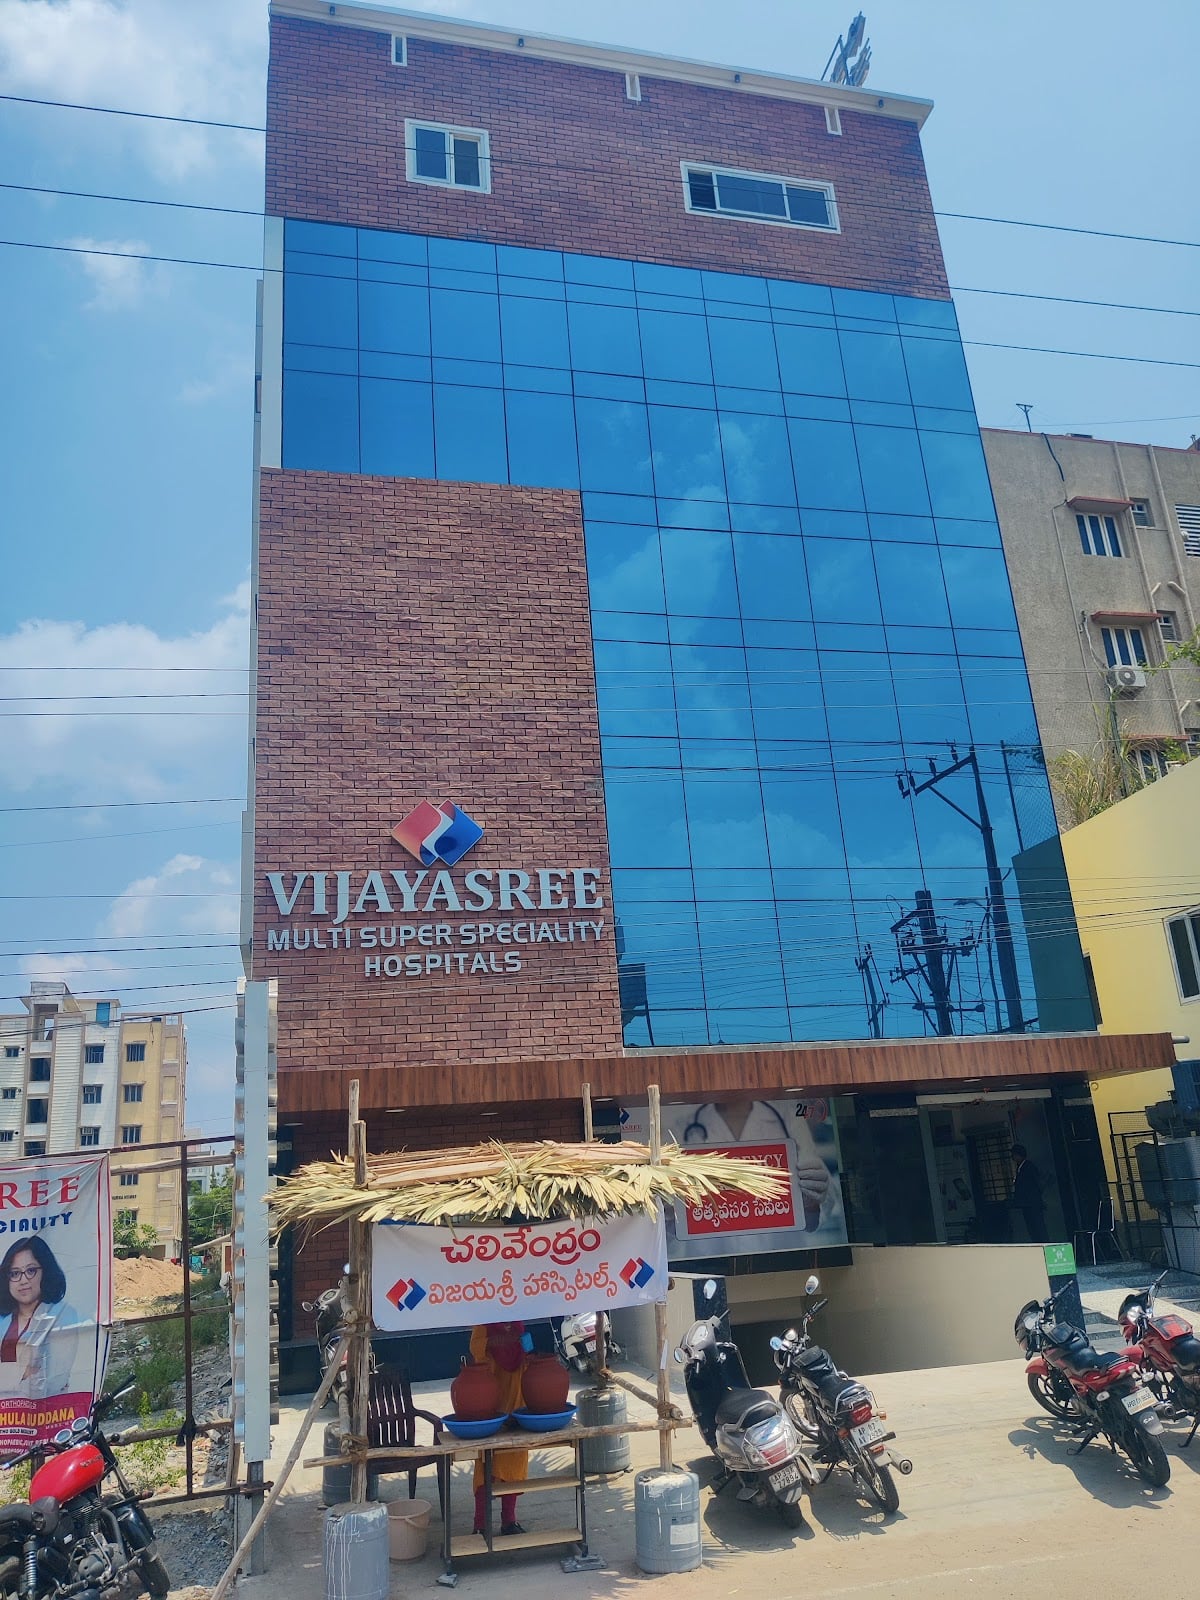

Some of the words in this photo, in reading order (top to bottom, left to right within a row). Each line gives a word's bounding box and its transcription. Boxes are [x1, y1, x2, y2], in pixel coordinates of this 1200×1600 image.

[265, 868, 603, 925] VIJAYASREE
[267, 927, 352, 951] MULTI
[359, 924, 452, 948] SUPER
[459, 919, 605, 945] SPECIALITY
[364, 951, 522, 977] HOSPITALS
[0, 1176, 79, 1209] REE
[0, 1211, 73, 1234] CIALITY
[440, 1226, 601, 1265] చలివేంద్రం
[428, 1269, 518, 1306] విజయశ్రీ
[522, 1261, 618, 1300] హాస్పిటల్స్
